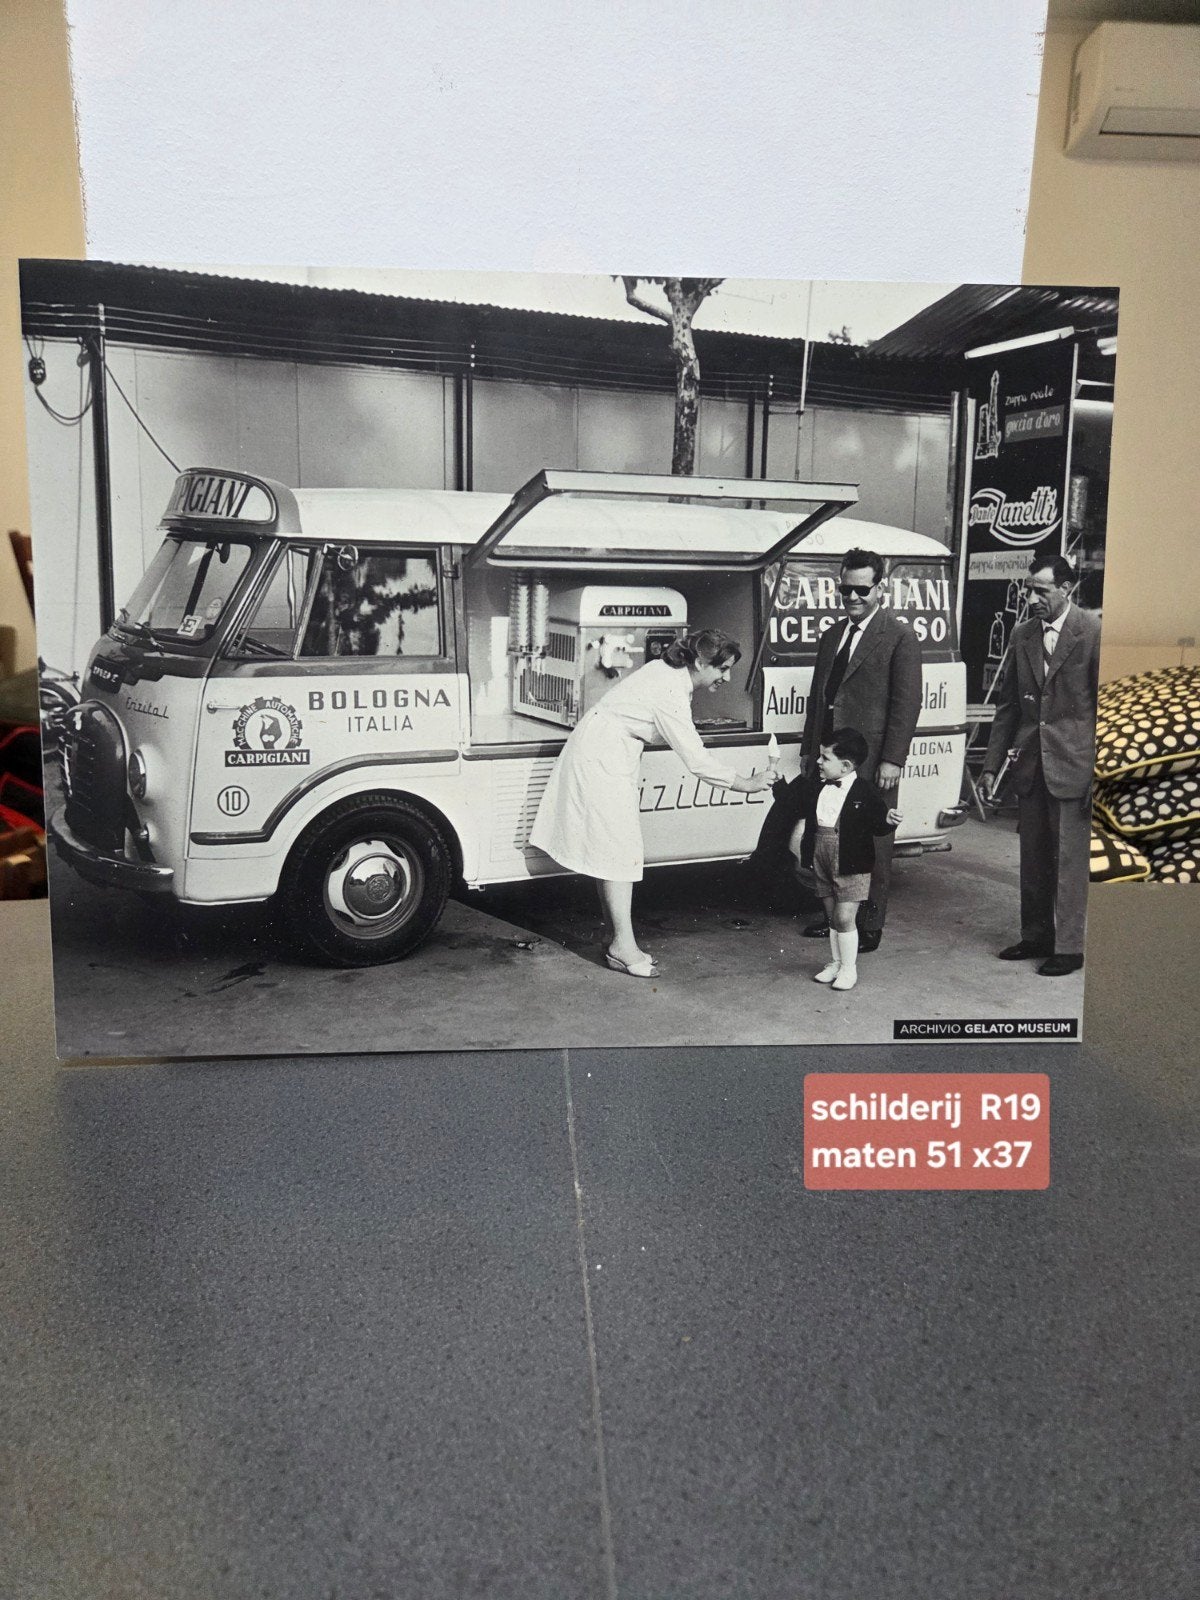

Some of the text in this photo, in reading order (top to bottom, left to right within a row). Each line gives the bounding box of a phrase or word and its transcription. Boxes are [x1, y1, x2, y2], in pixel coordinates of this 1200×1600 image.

[173, 474, 253, 518] PIGIANI
[768, 576, 951, 610] CARGIANI
[602, 606, 667, 615] CARPIGIANI
[308, 688, 452, 711] BOLOGNA
[766, 681, 948, 715] Auto lati
[236, 701, 300, 746] MACCHINE AUTOMATICHE
[347, 715, 413, 733] ITALIA
[912, 741, 953, 756] LOGNA
[227, 752, 308, 765] CARPIGIANI
[902, 764, 939, 779] ITALIA
[225, 790, 241, 811] 10
[900, 1022, 1071, 1034] ARCHIVIO GELATO MUSEUM
